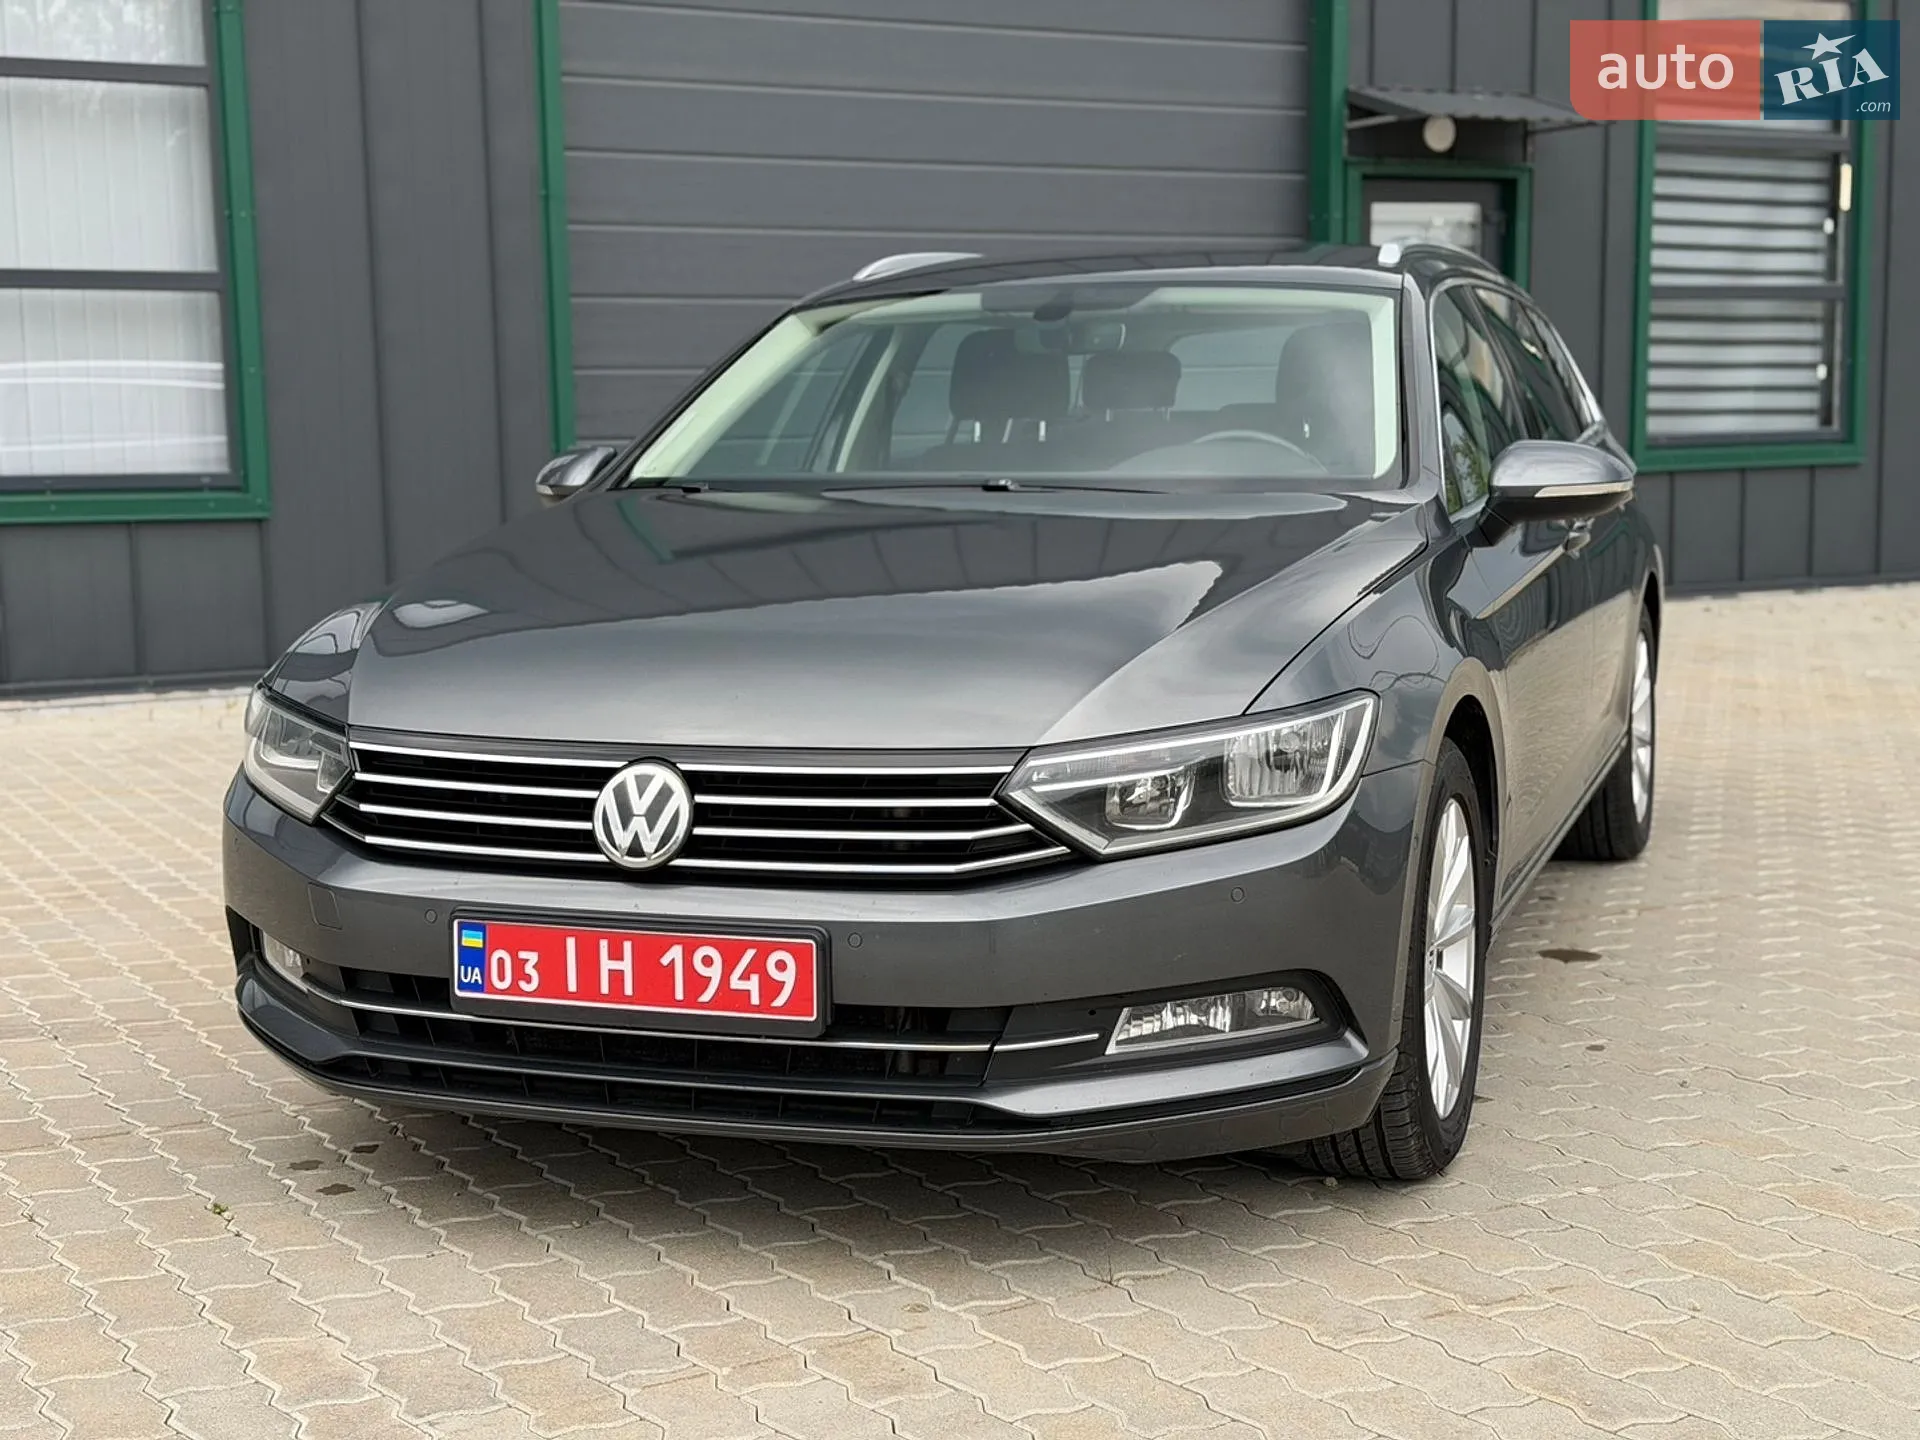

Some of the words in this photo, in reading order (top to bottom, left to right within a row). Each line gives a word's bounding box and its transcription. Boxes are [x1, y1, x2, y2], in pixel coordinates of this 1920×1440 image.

[460, 965, 483, 985] UA
[490, 949, 540, 993] 03
[659, 944, 797, 1008] 1949
